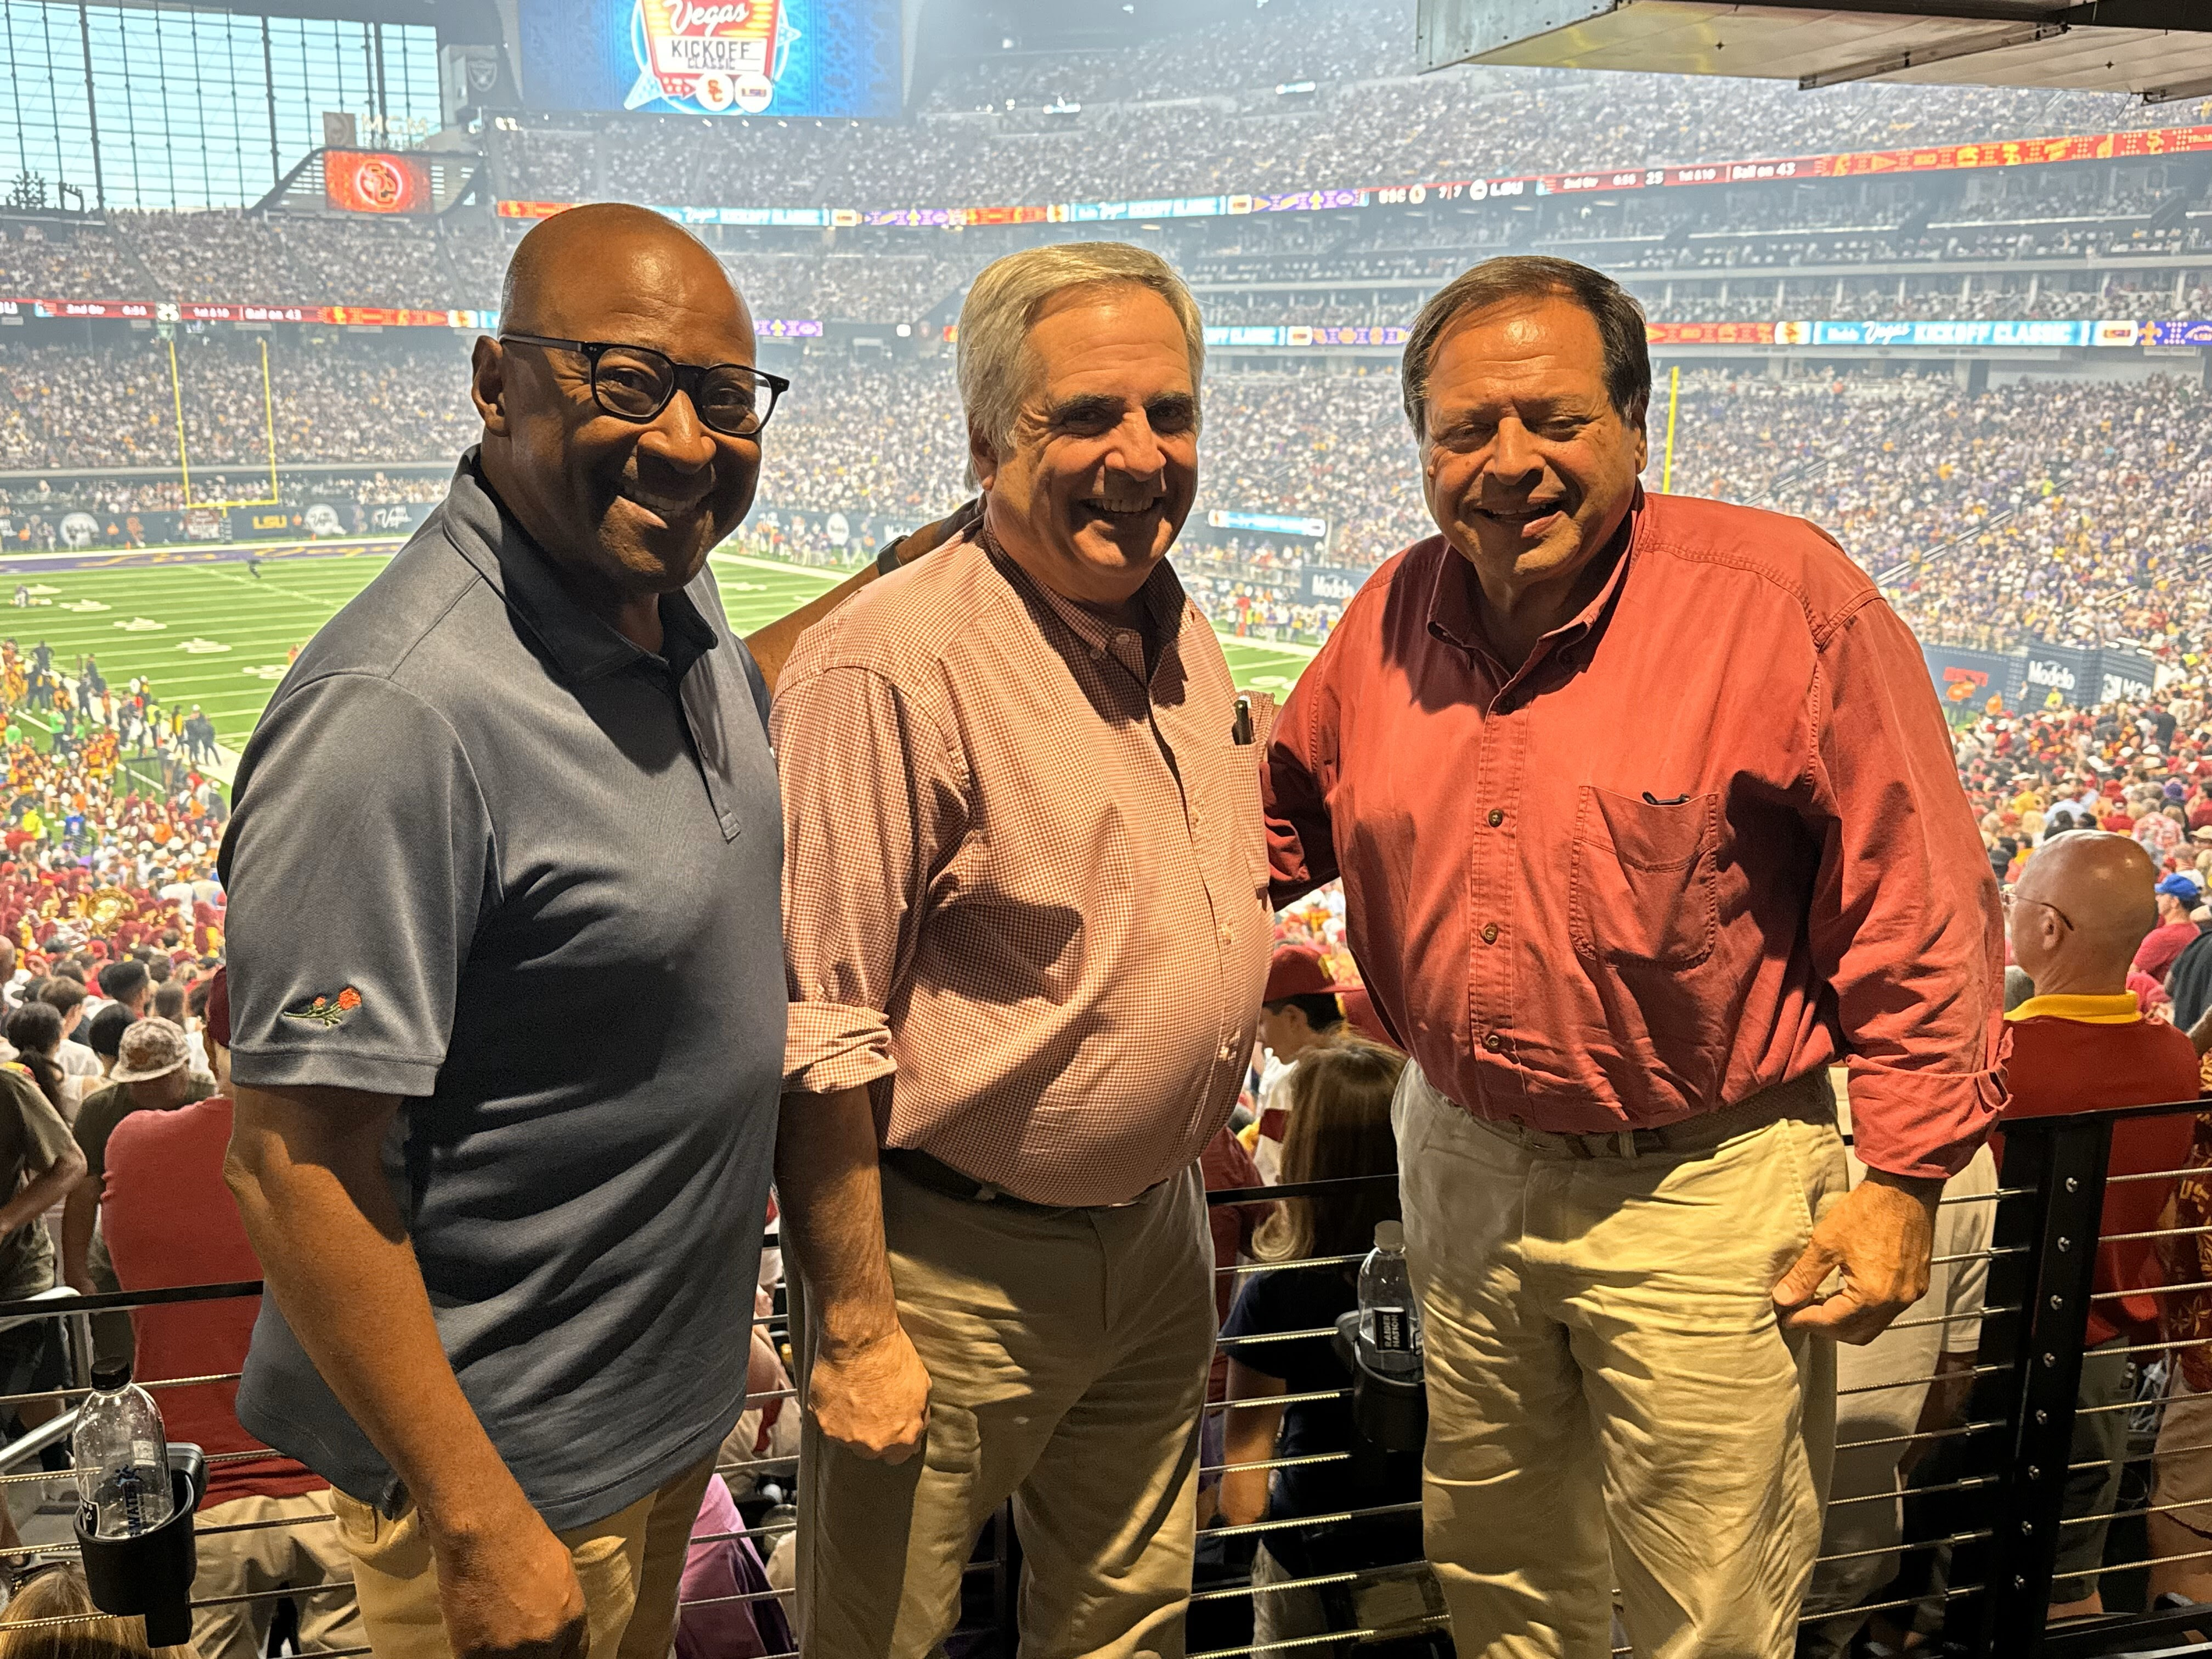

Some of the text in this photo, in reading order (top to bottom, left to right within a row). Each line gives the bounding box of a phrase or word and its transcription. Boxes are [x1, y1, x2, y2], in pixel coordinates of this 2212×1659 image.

[663, 0, 749, 37] Vegas
[671, 40, 751, 58] KICKOFF
[687, 58, 736, 70] CLASSIC
[361, 113, 429, 138] MGM
[1776, 161, 1796, 176] 43
[1861, 320, 1912, 345] Vegas
[1914, 323, 1990, 343] KICKOFF
[1993, 323, 2072, 344] CLASSIC
[253, 515, 287, 529] LSU
[2028, 661, 2075, 690] Modelo
[1383, 1314, 1392, 1347] RAIDER
[1391, 1314, 1400, 1347] NATION
